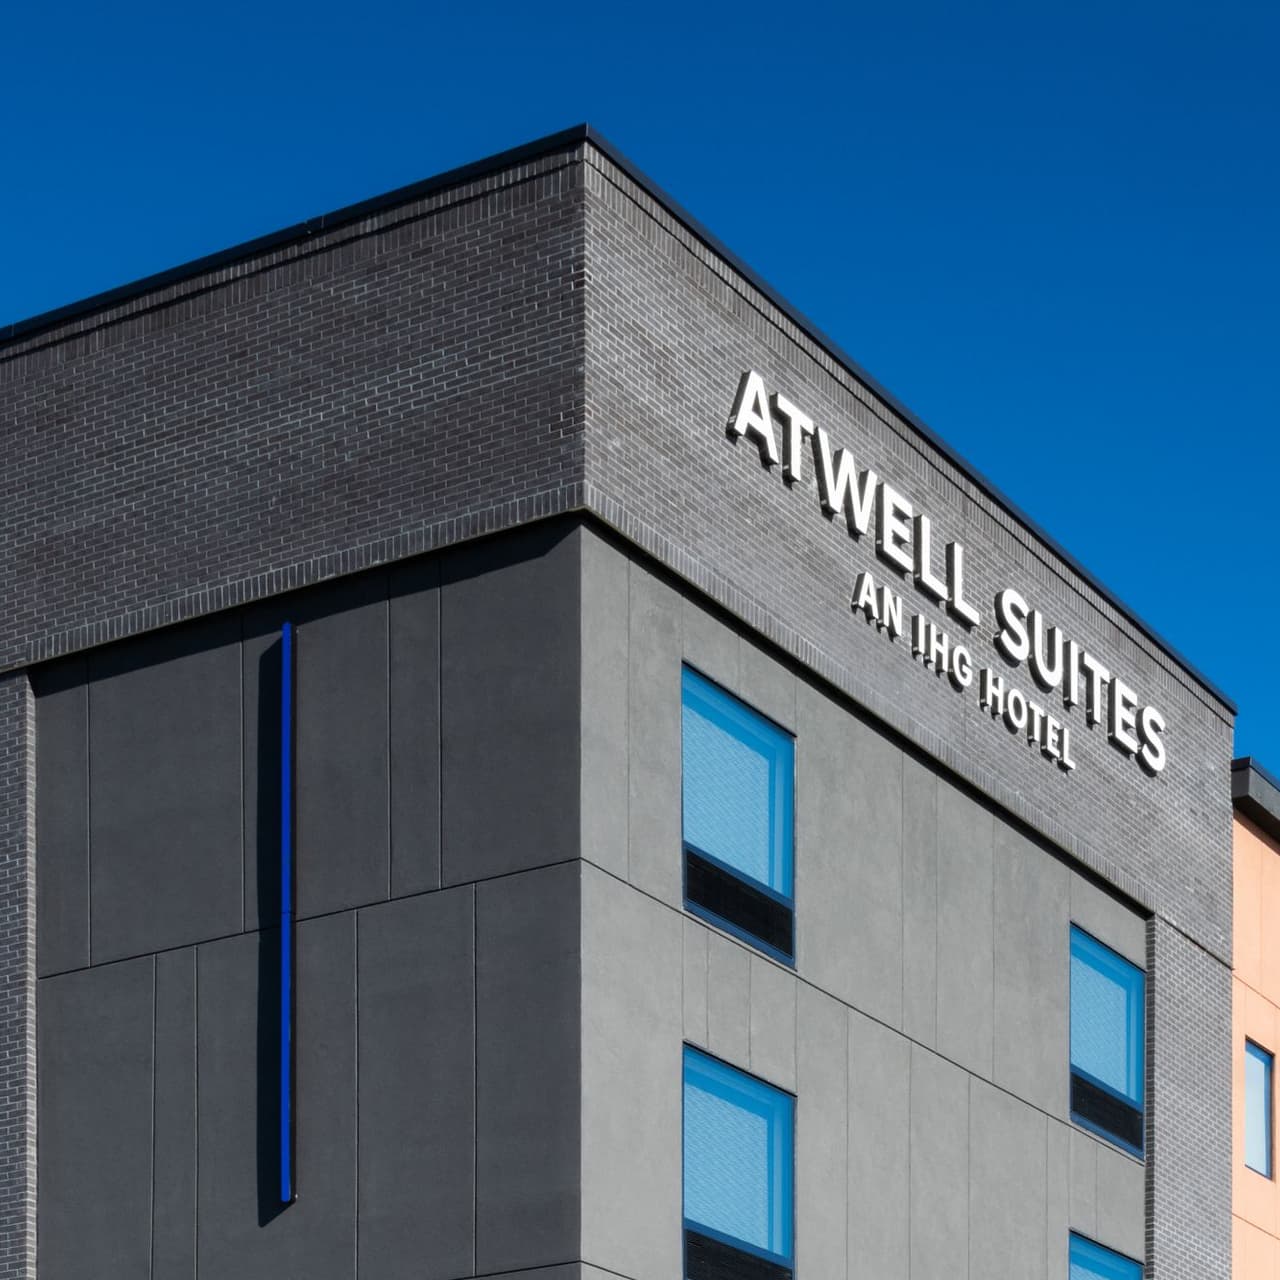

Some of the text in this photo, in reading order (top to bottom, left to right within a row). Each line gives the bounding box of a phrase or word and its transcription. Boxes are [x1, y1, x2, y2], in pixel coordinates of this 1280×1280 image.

[727, 370, 1167, 773] ATWELL SUITES
[852, 572, 1076, 771] AN IHG HOTEL
